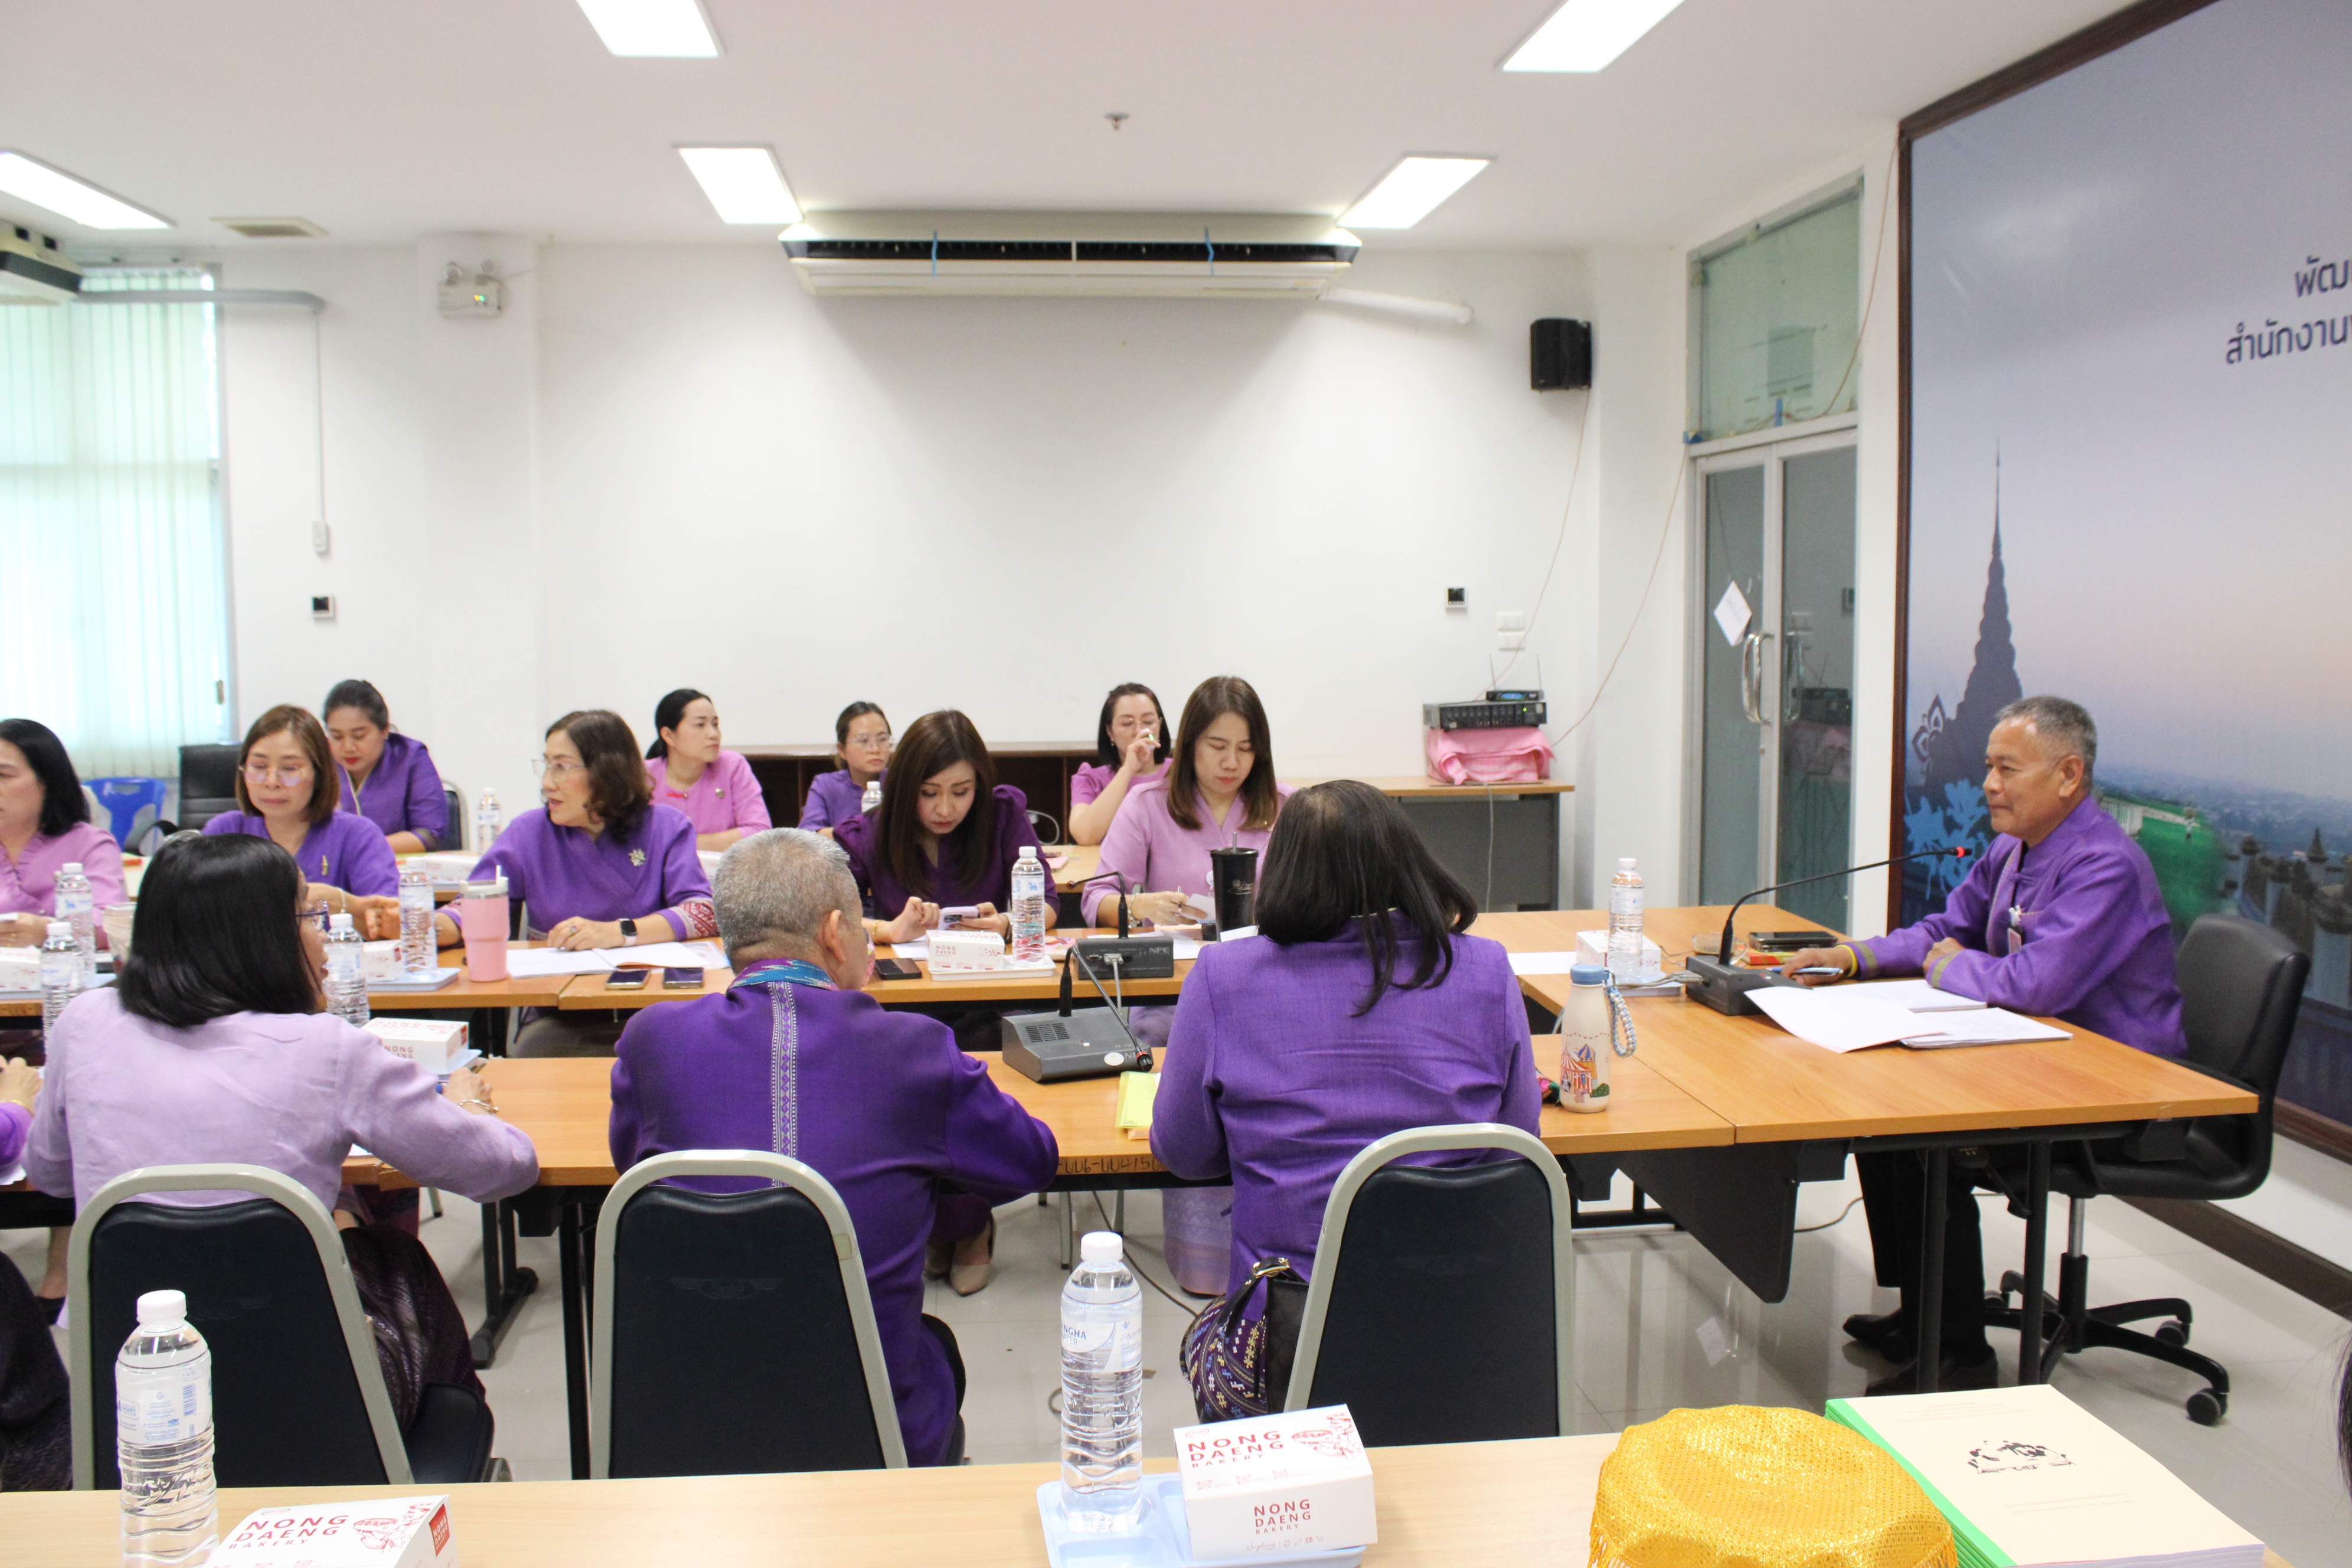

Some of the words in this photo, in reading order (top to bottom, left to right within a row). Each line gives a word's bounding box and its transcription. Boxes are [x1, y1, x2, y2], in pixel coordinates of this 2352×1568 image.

[2295, 255, 2352, 298] พัฒ
[2226, 316, 2352, 364] สำนักงาน
[1062, 1322, 1087, 1340] INGHA
[1188, 1430, 1281, 1452] NONG
[1190, 1441, 1284, 1462] DAENG
[1192, 1453, 1263, 1468] BAKERY
[1254, 1498, 1310, 1517] NONG
[244, 1515, 349, 1531] NONG
[1255, 1511, 1311, 1527] DAENG
[234, 1526, 341, 1542] DAENG
[1256, 1523, 1299, 1534] BAKERY
[228, 1538, 309, 1550] BAKERY
